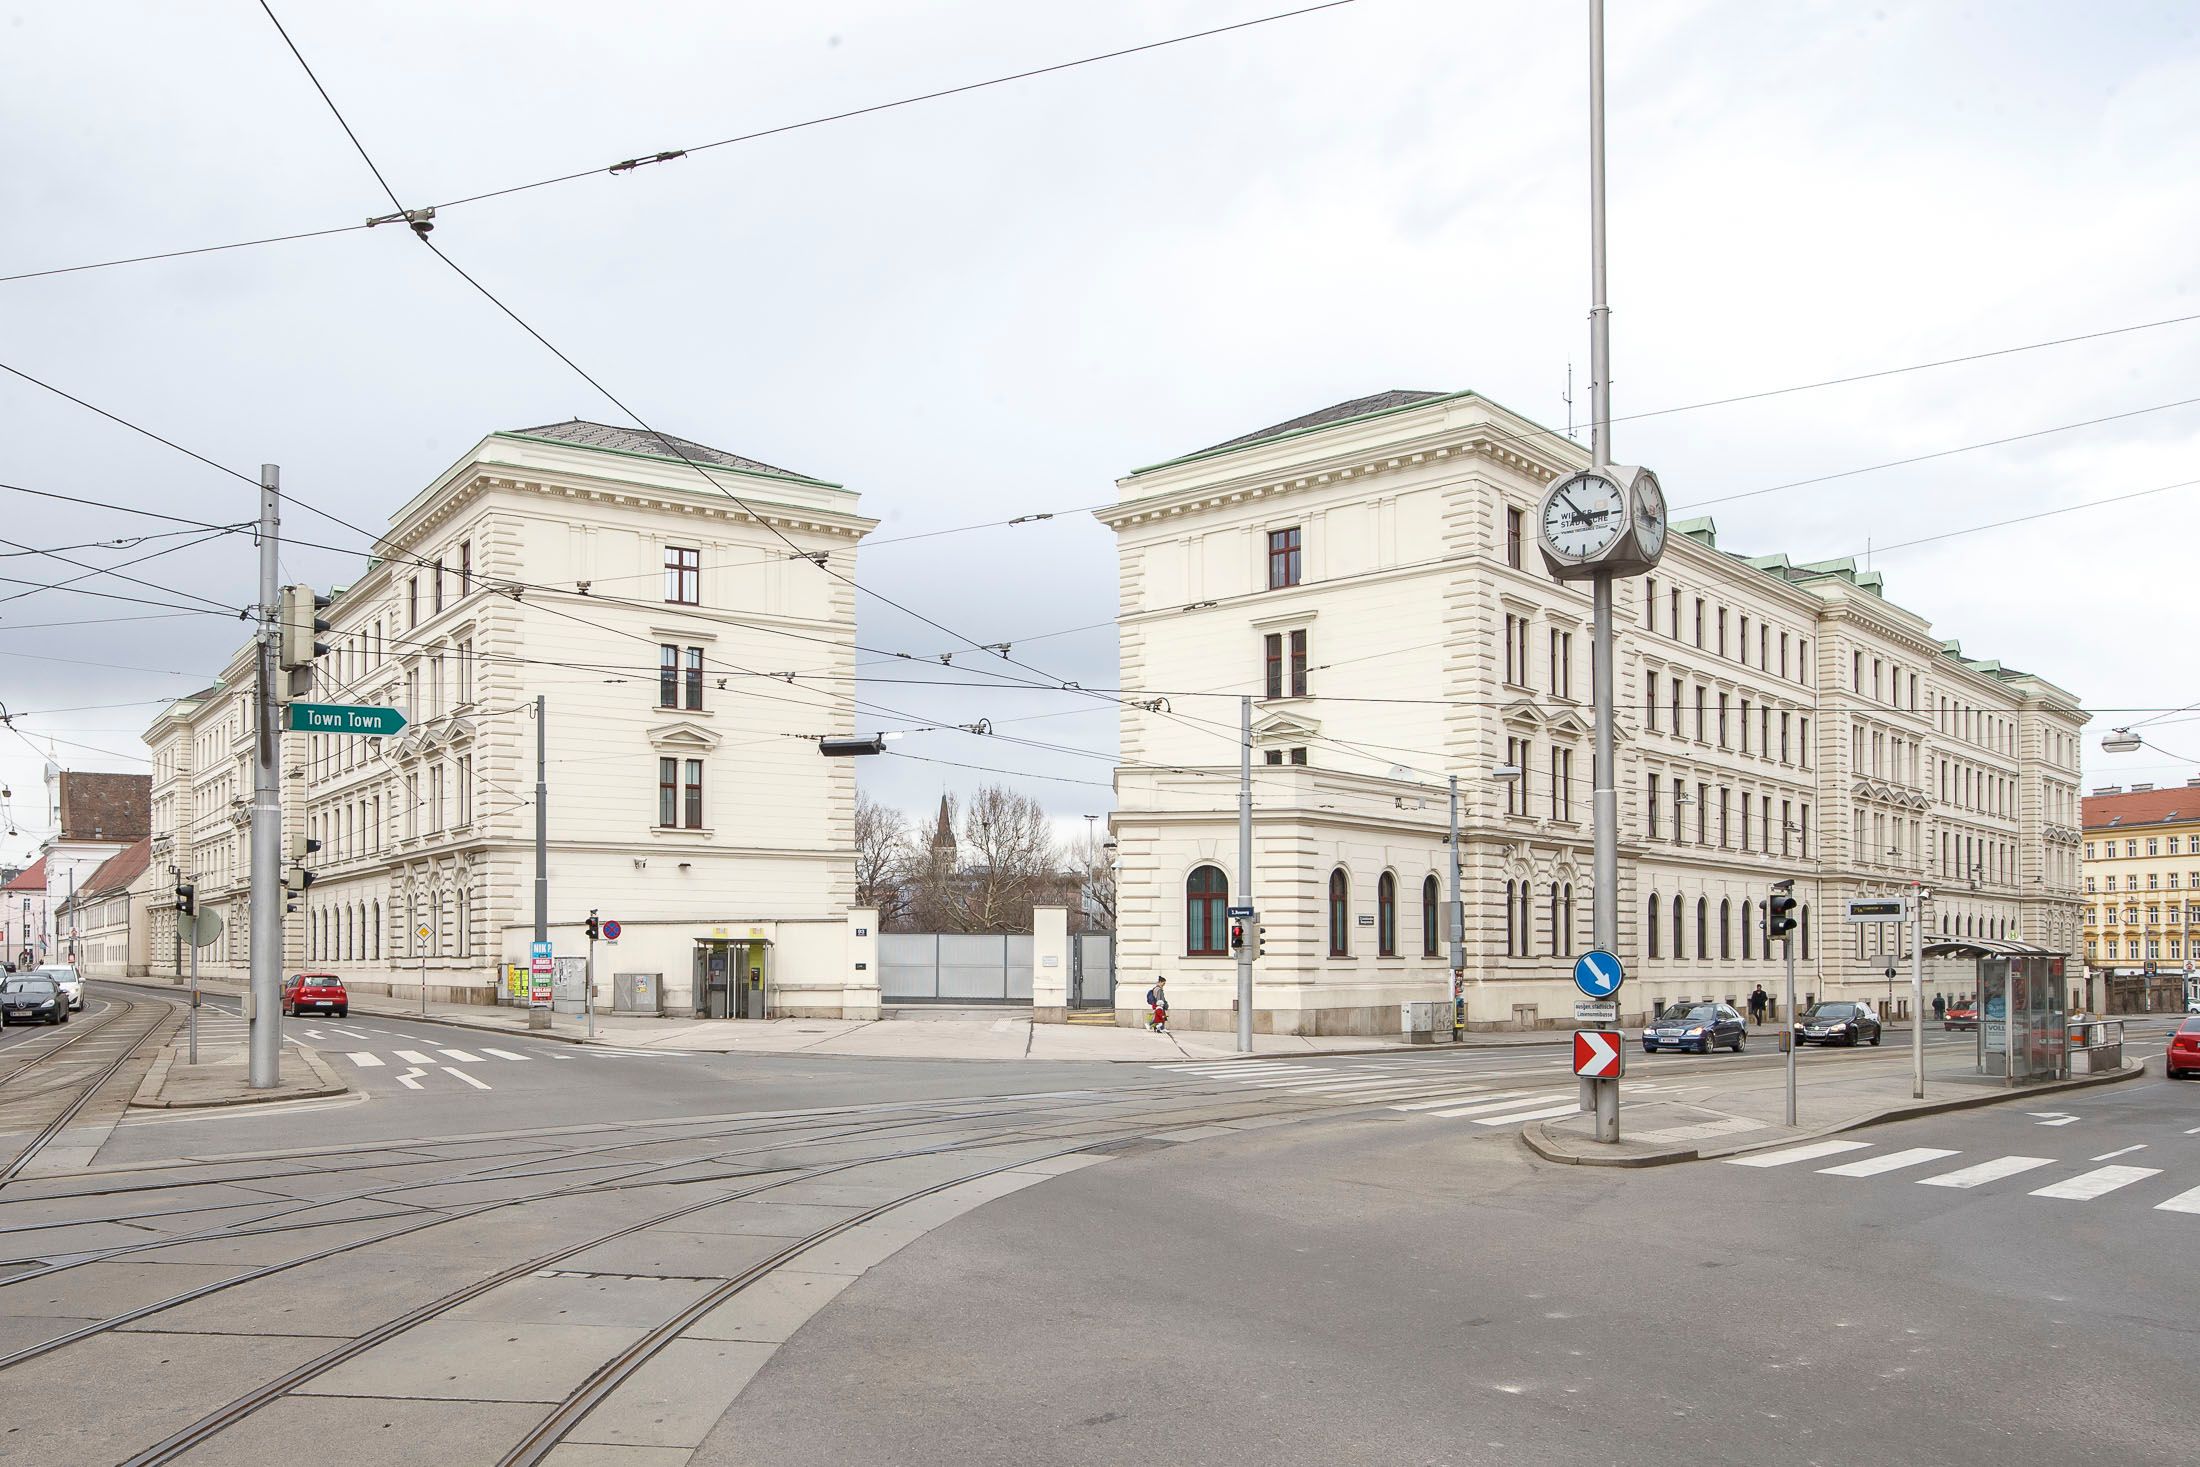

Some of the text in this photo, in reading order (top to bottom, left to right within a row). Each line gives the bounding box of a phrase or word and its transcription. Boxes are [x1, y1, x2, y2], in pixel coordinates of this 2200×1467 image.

[1560, 509, 1593, 520] WIEER
[307, 709, 382, 729] Town Town
